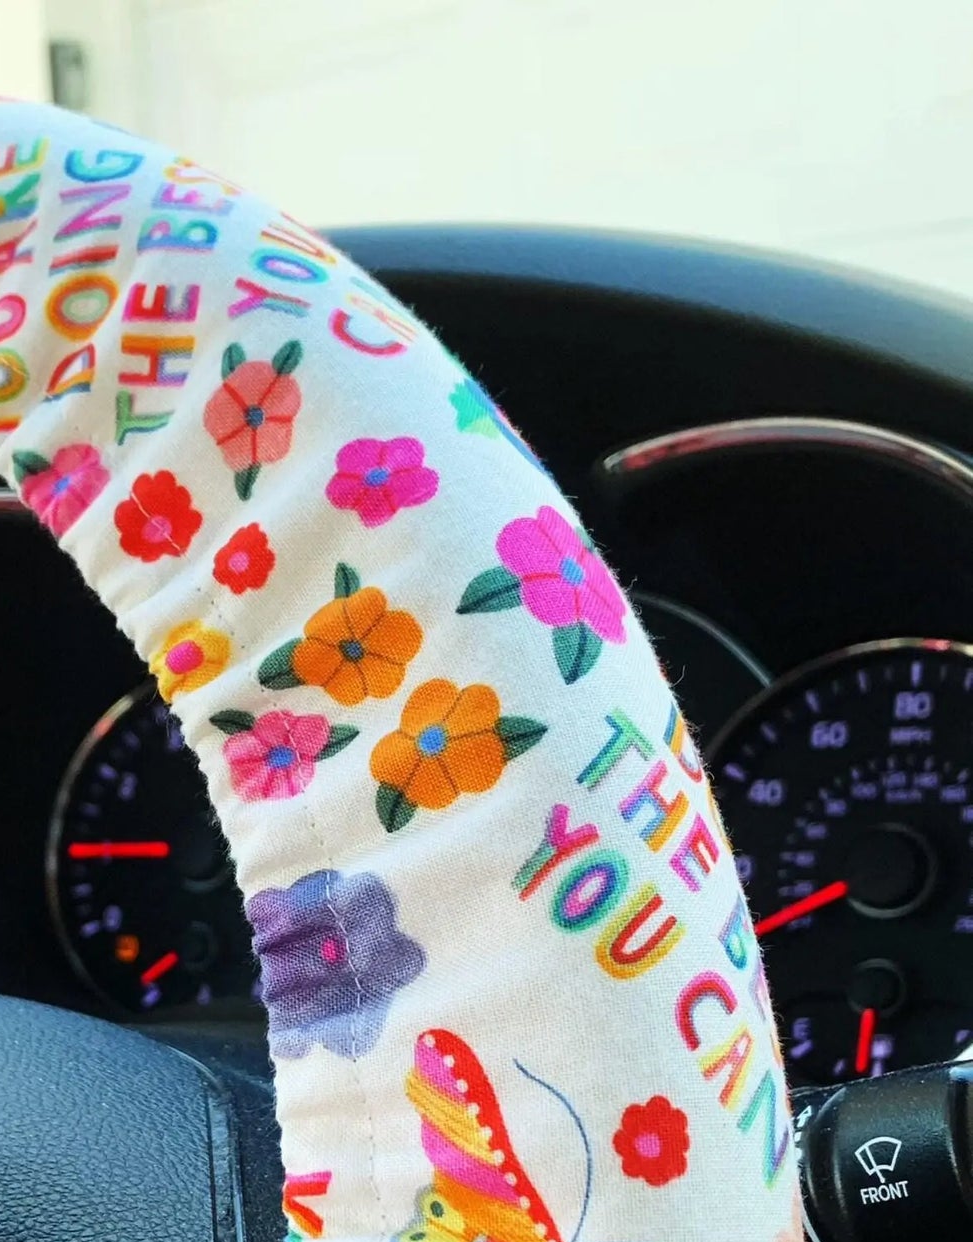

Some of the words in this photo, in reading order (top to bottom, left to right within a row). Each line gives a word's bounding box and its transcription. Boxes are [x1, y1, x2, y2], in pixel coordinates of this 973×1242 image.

[41, 149, 146, 403] DOING
[227, 211, 338, 320] YOU
[113, 280, 202, 447] THE
[577, 708, 721, 893] THE
[810, 720, 848, 748] 60
[511, 803, 687, 980] YOU
[674, 969, 791, 1190] CAN
[859, 1180, 909, 1205] FRONT
